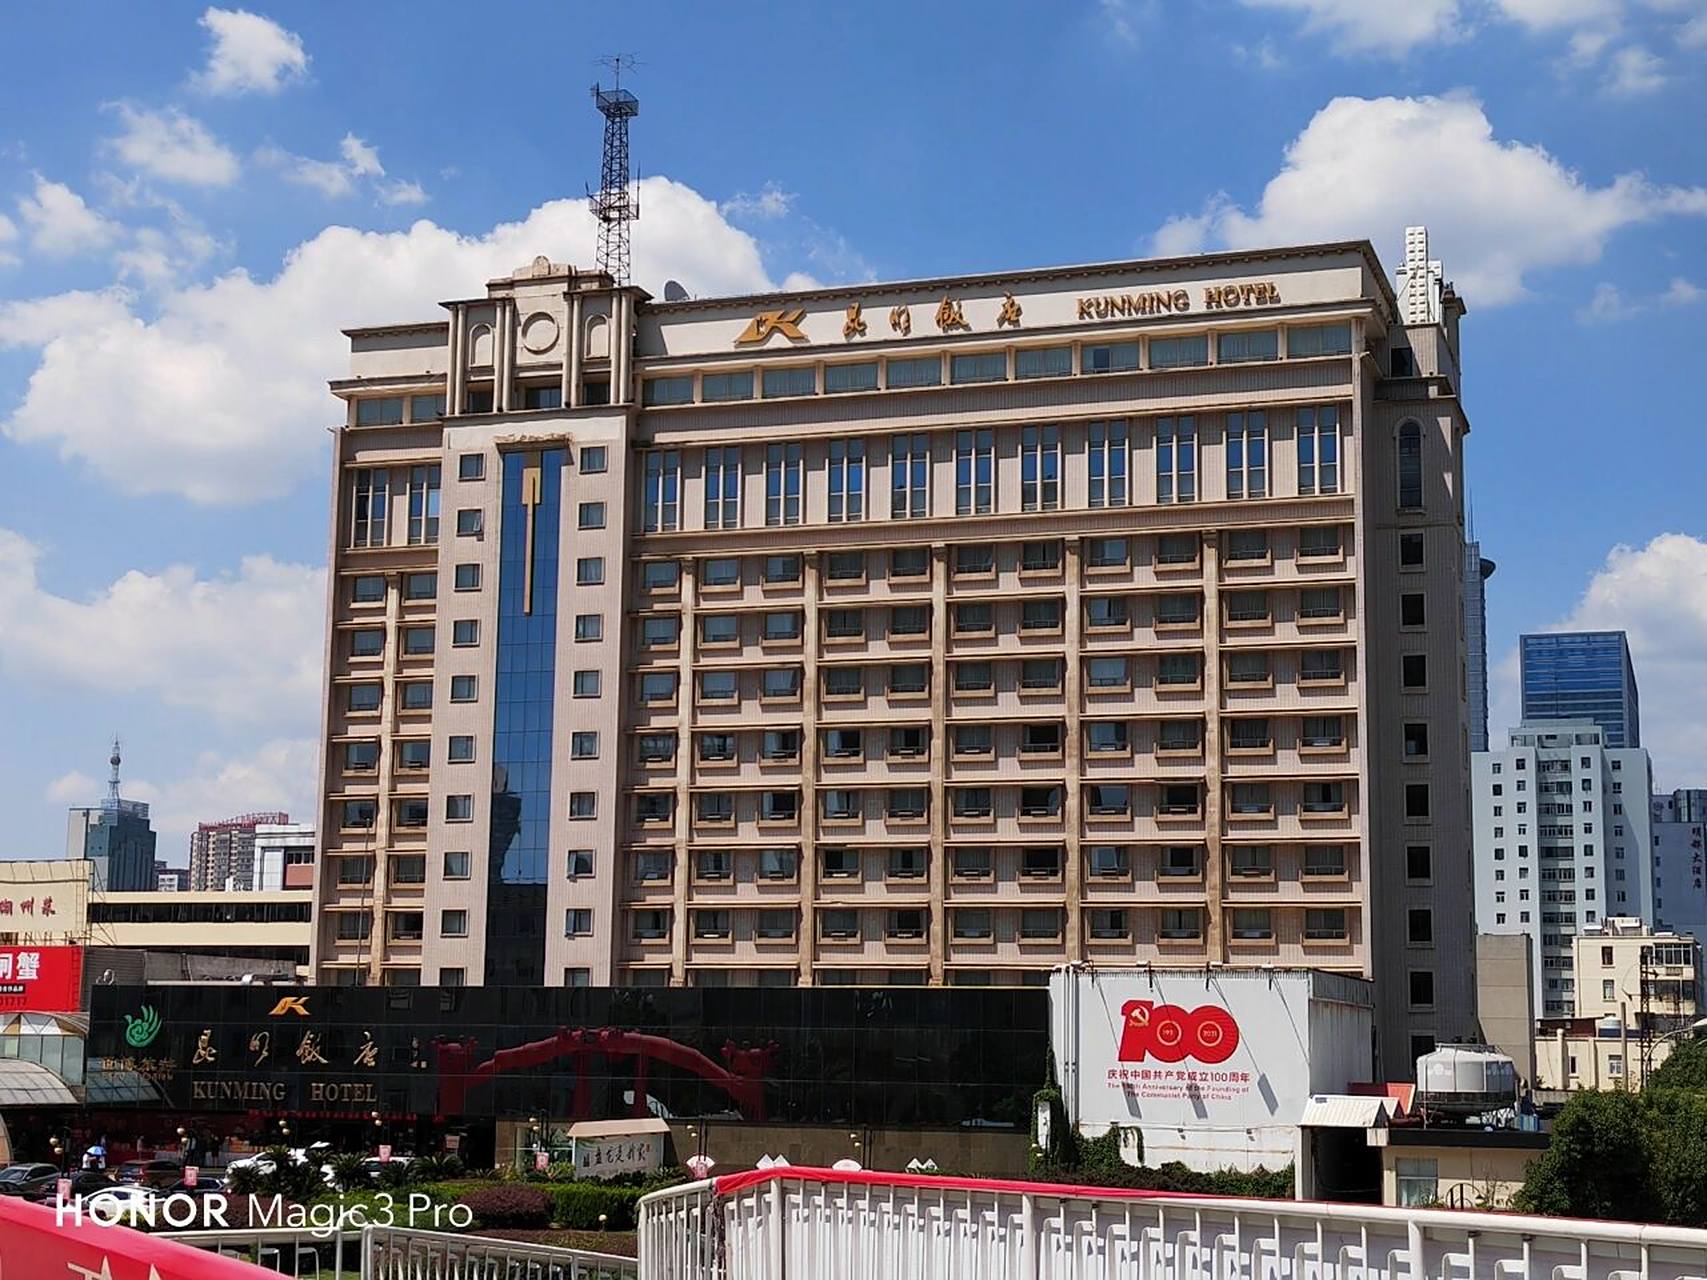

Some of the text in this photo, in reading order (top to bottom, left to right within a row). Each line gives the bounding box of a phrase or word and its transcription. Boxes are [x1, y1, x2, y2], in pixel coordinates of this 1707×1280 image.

[1077, 282, 1282, 320] KUNMING HOTEL
[1118, 999, 1240, 1064] 100
[1107, 1069, 1250, 1083] 庆祝中国共产党成立100周年
[192, 1081, 378, 1102] KUNMING HOTEL
[1142, 1083, 1183, 1092] Anniversary
